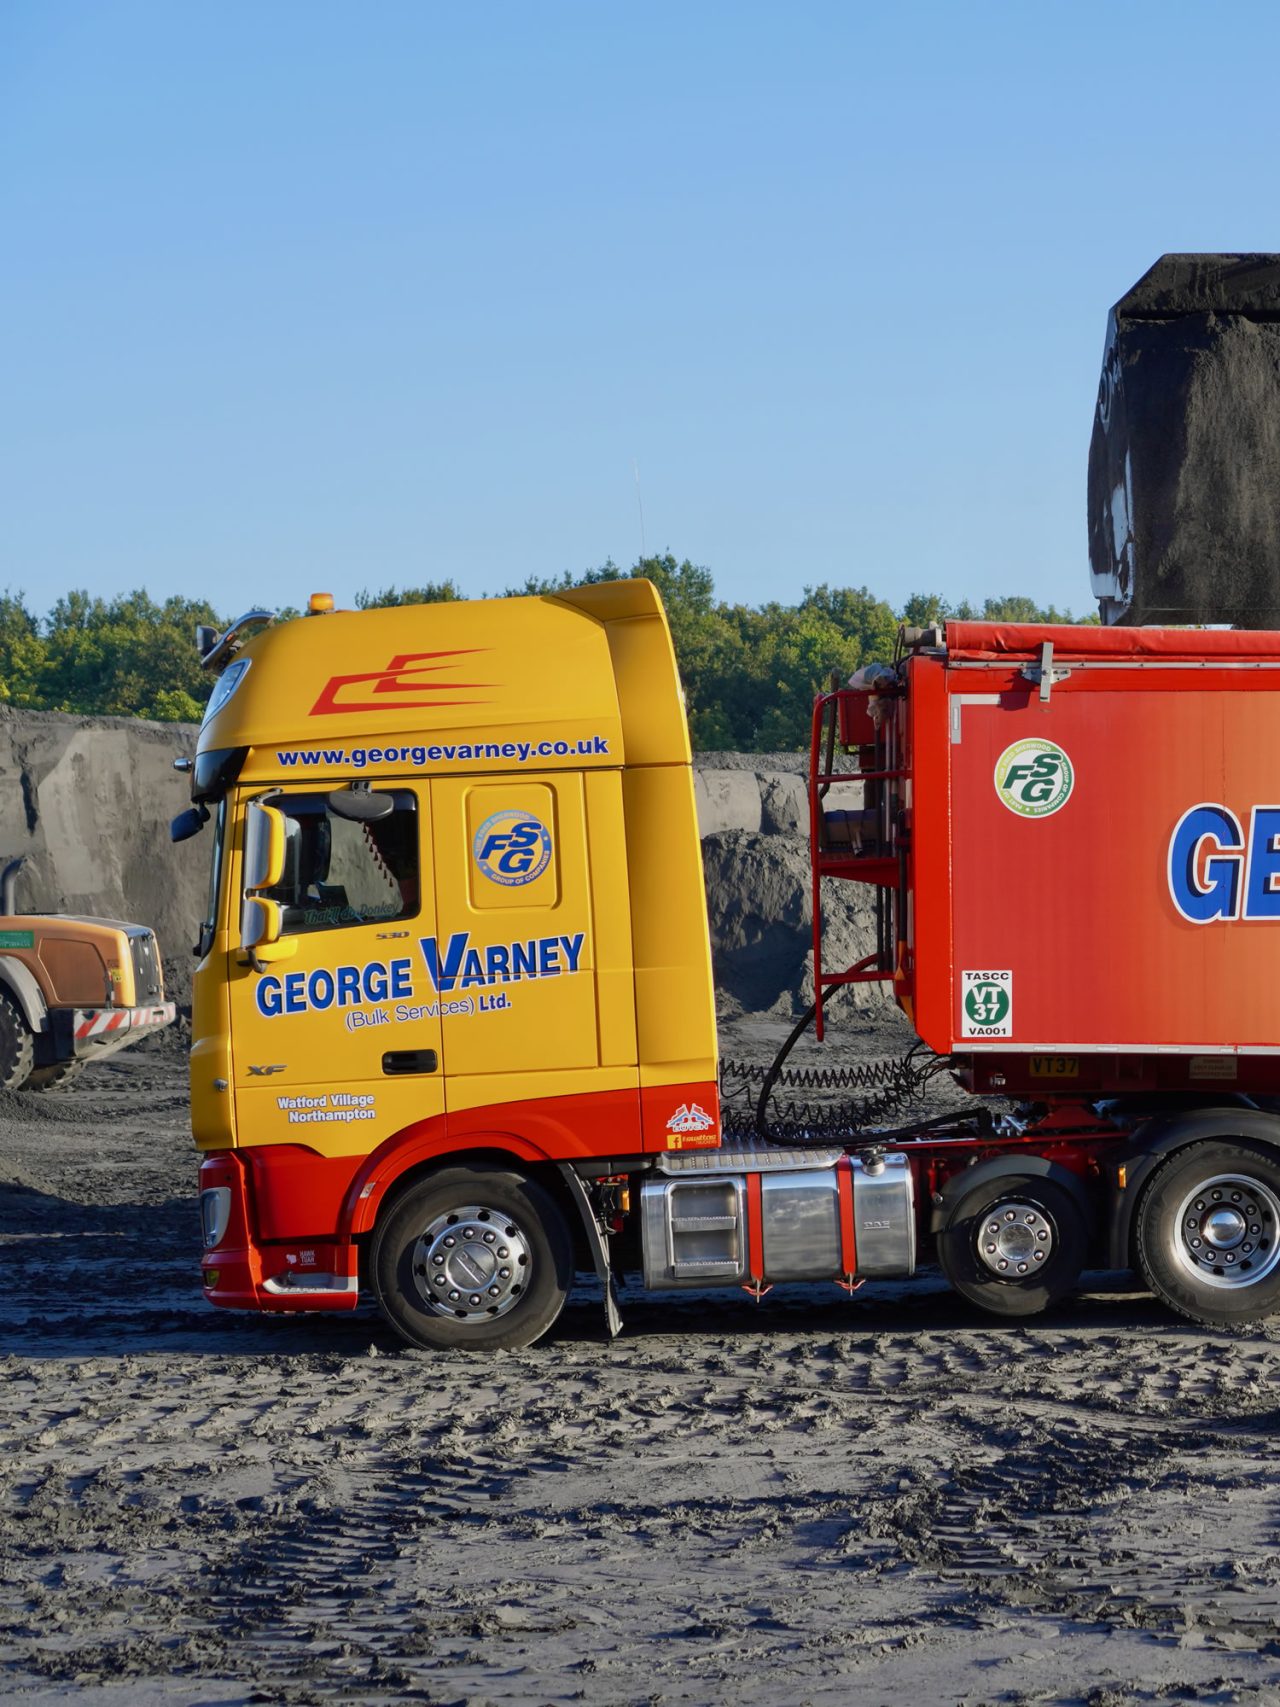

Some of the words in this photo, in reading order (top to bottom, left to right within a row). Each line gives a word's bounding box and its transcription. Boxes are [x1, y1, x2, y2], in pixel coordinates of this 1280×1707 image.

[277, 736, 609, 768] www.georgevarney.co.uk
[491, 873, 515, 885] GROUP
[514, 877, 525, 885] OF
[524, 849, 551, 882] COMPANIES
[359, 901, 400, 918] Donkey
[256, 958, 413, 1018] GEORGE
[419, 932, 586, 993] VARNEY
[965, 972, 1009, 981] TASCC
[972, 986, 1003, 1003] VT
[345, 1004, 391, 1032] (Bulk
[395, 997, 476, 1024] Services)
[478, 992, 513, 1012] Ltd.
[973, 1003, 1001, 1021] 37
[968, 1027, 1007, 1036] VA001
[245, 1064, 288, 1077] XF
[1033, 1056, 1079, 1074] VT37
[277, 1095, 327, 1110] Watford
[330, 1094, 375, 1108] Village
[288, 1108, 376, 1124] Northampton
